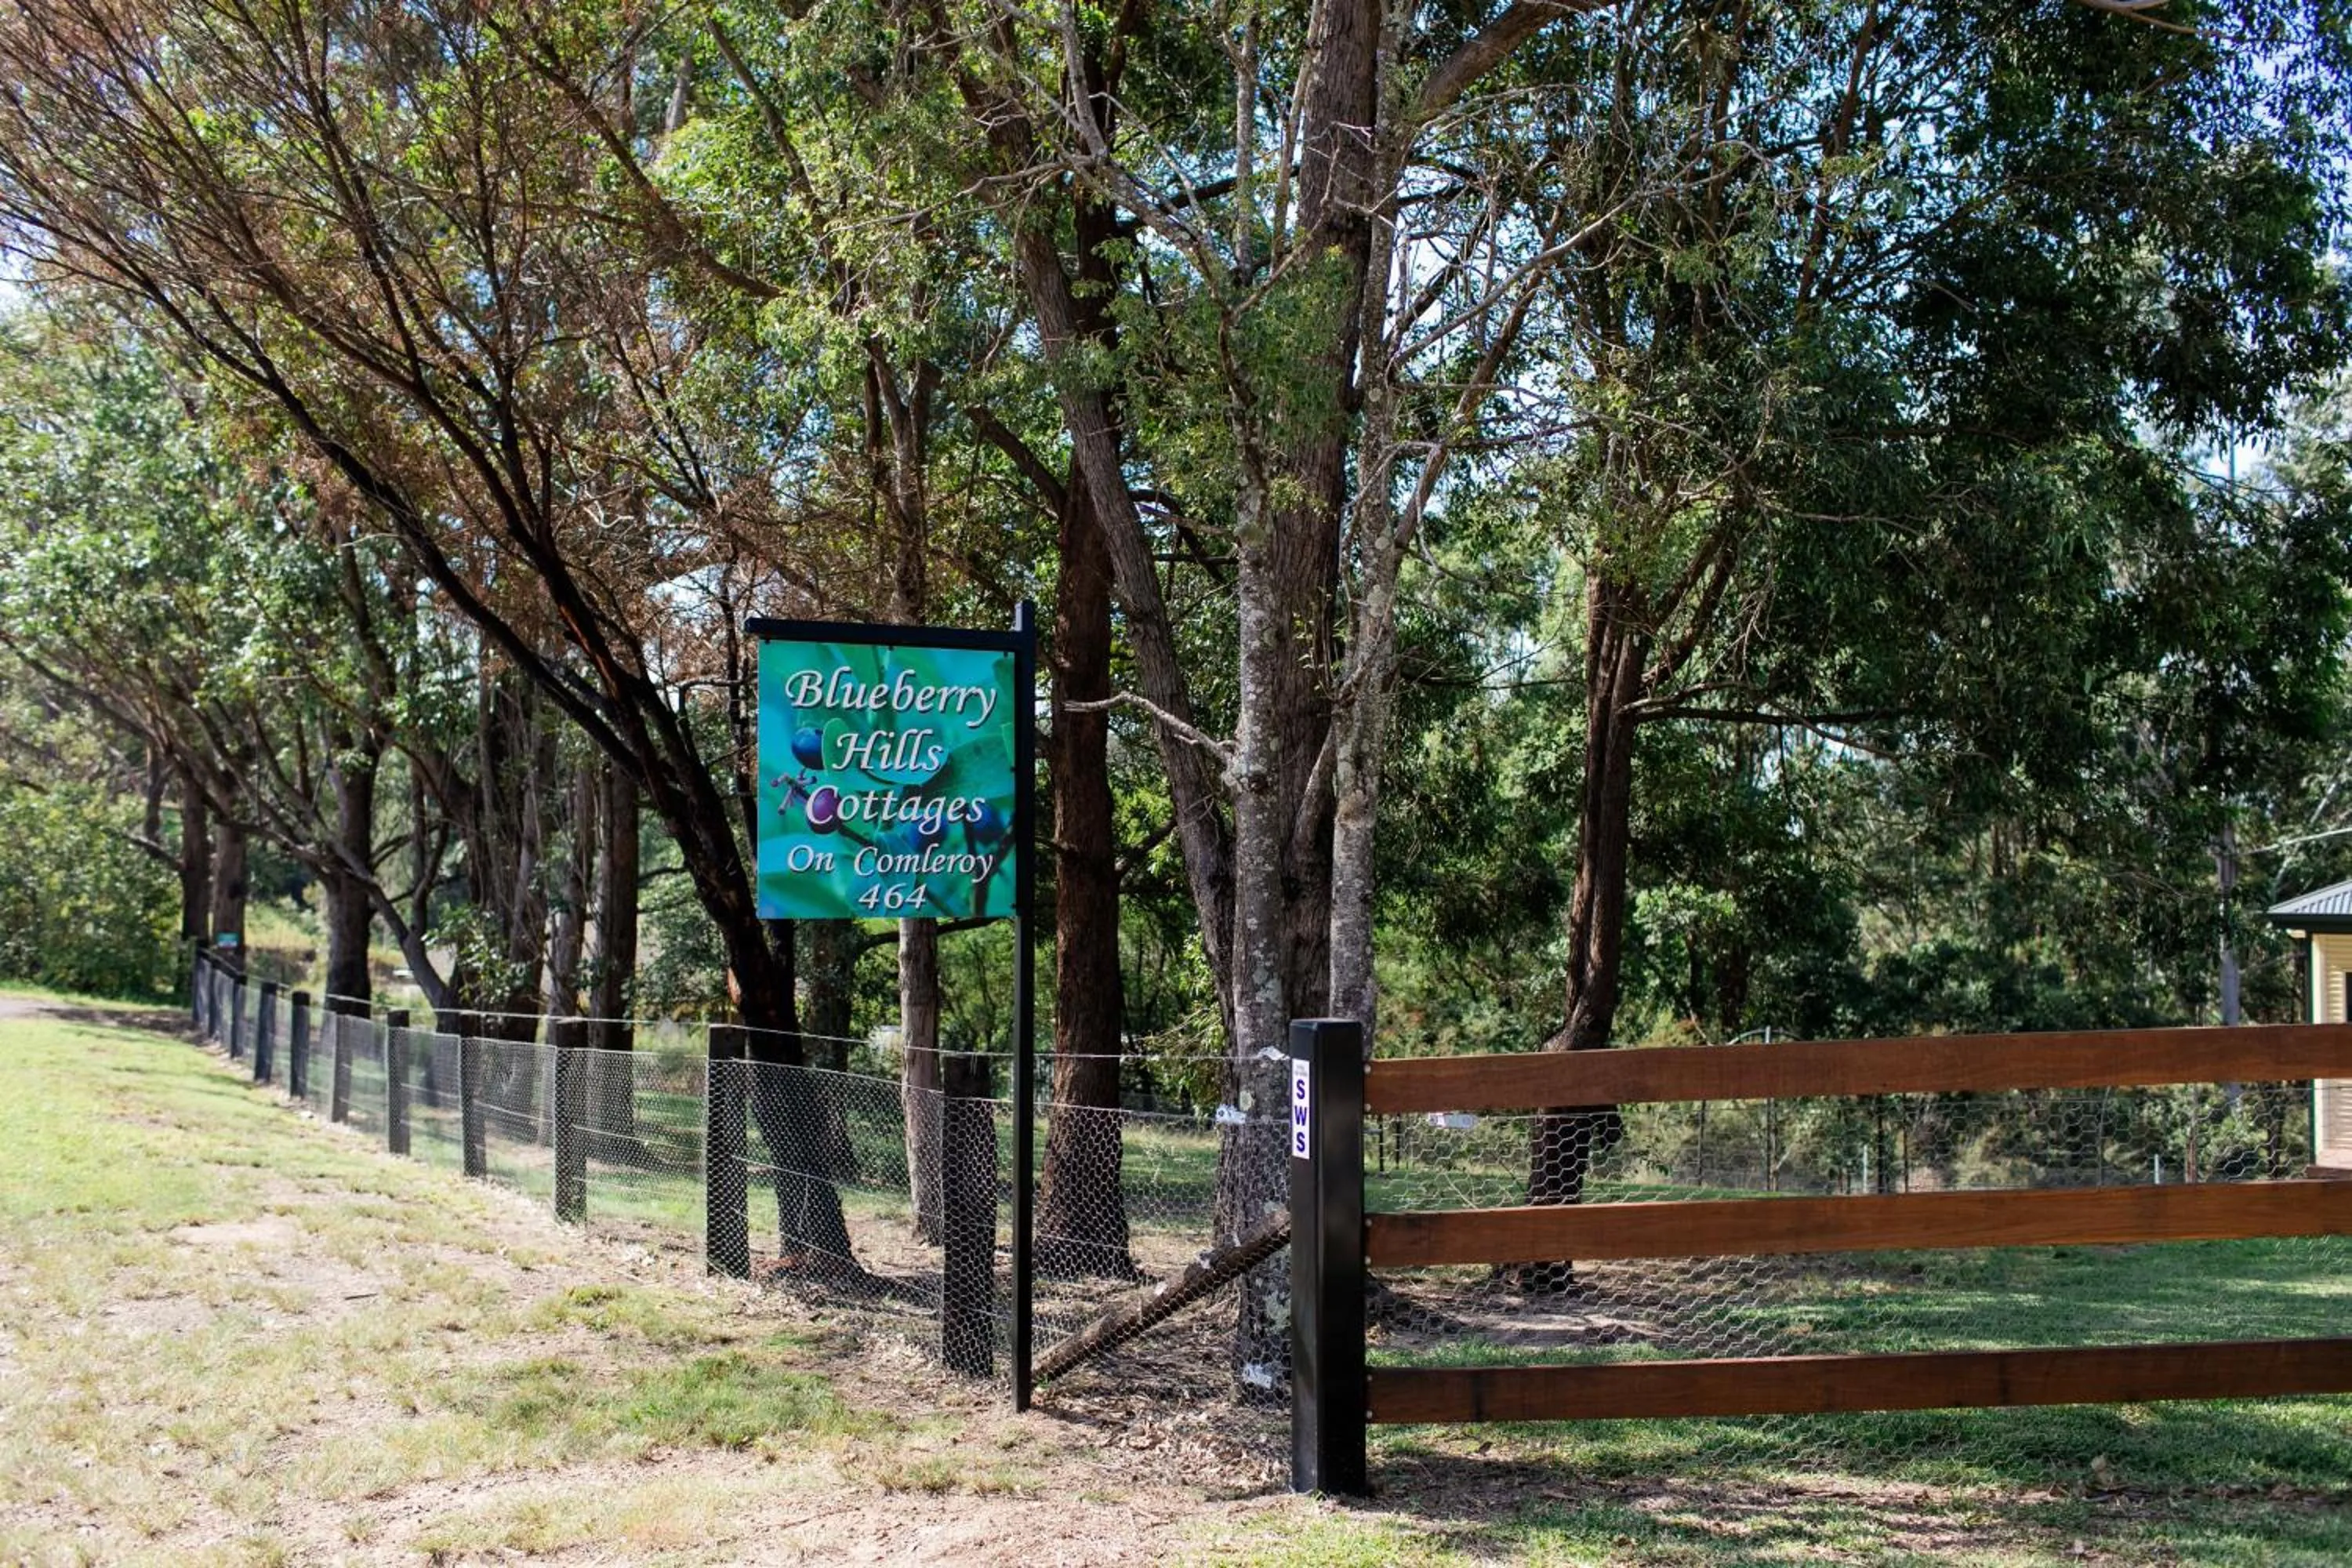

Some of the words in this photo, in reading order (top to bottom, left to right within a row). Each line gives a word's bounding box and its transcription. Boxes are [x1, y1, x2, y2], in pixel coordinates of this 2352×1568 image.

[786, 666, 996, 727] Blueberry
[832, 728, 945, 771] Hills
[806, 785, 985, 835] Cottages
[788, 845, 835, 872] On
[854, 843, 994, 883] Comleroy
[858, 883, 927, 910] 464
